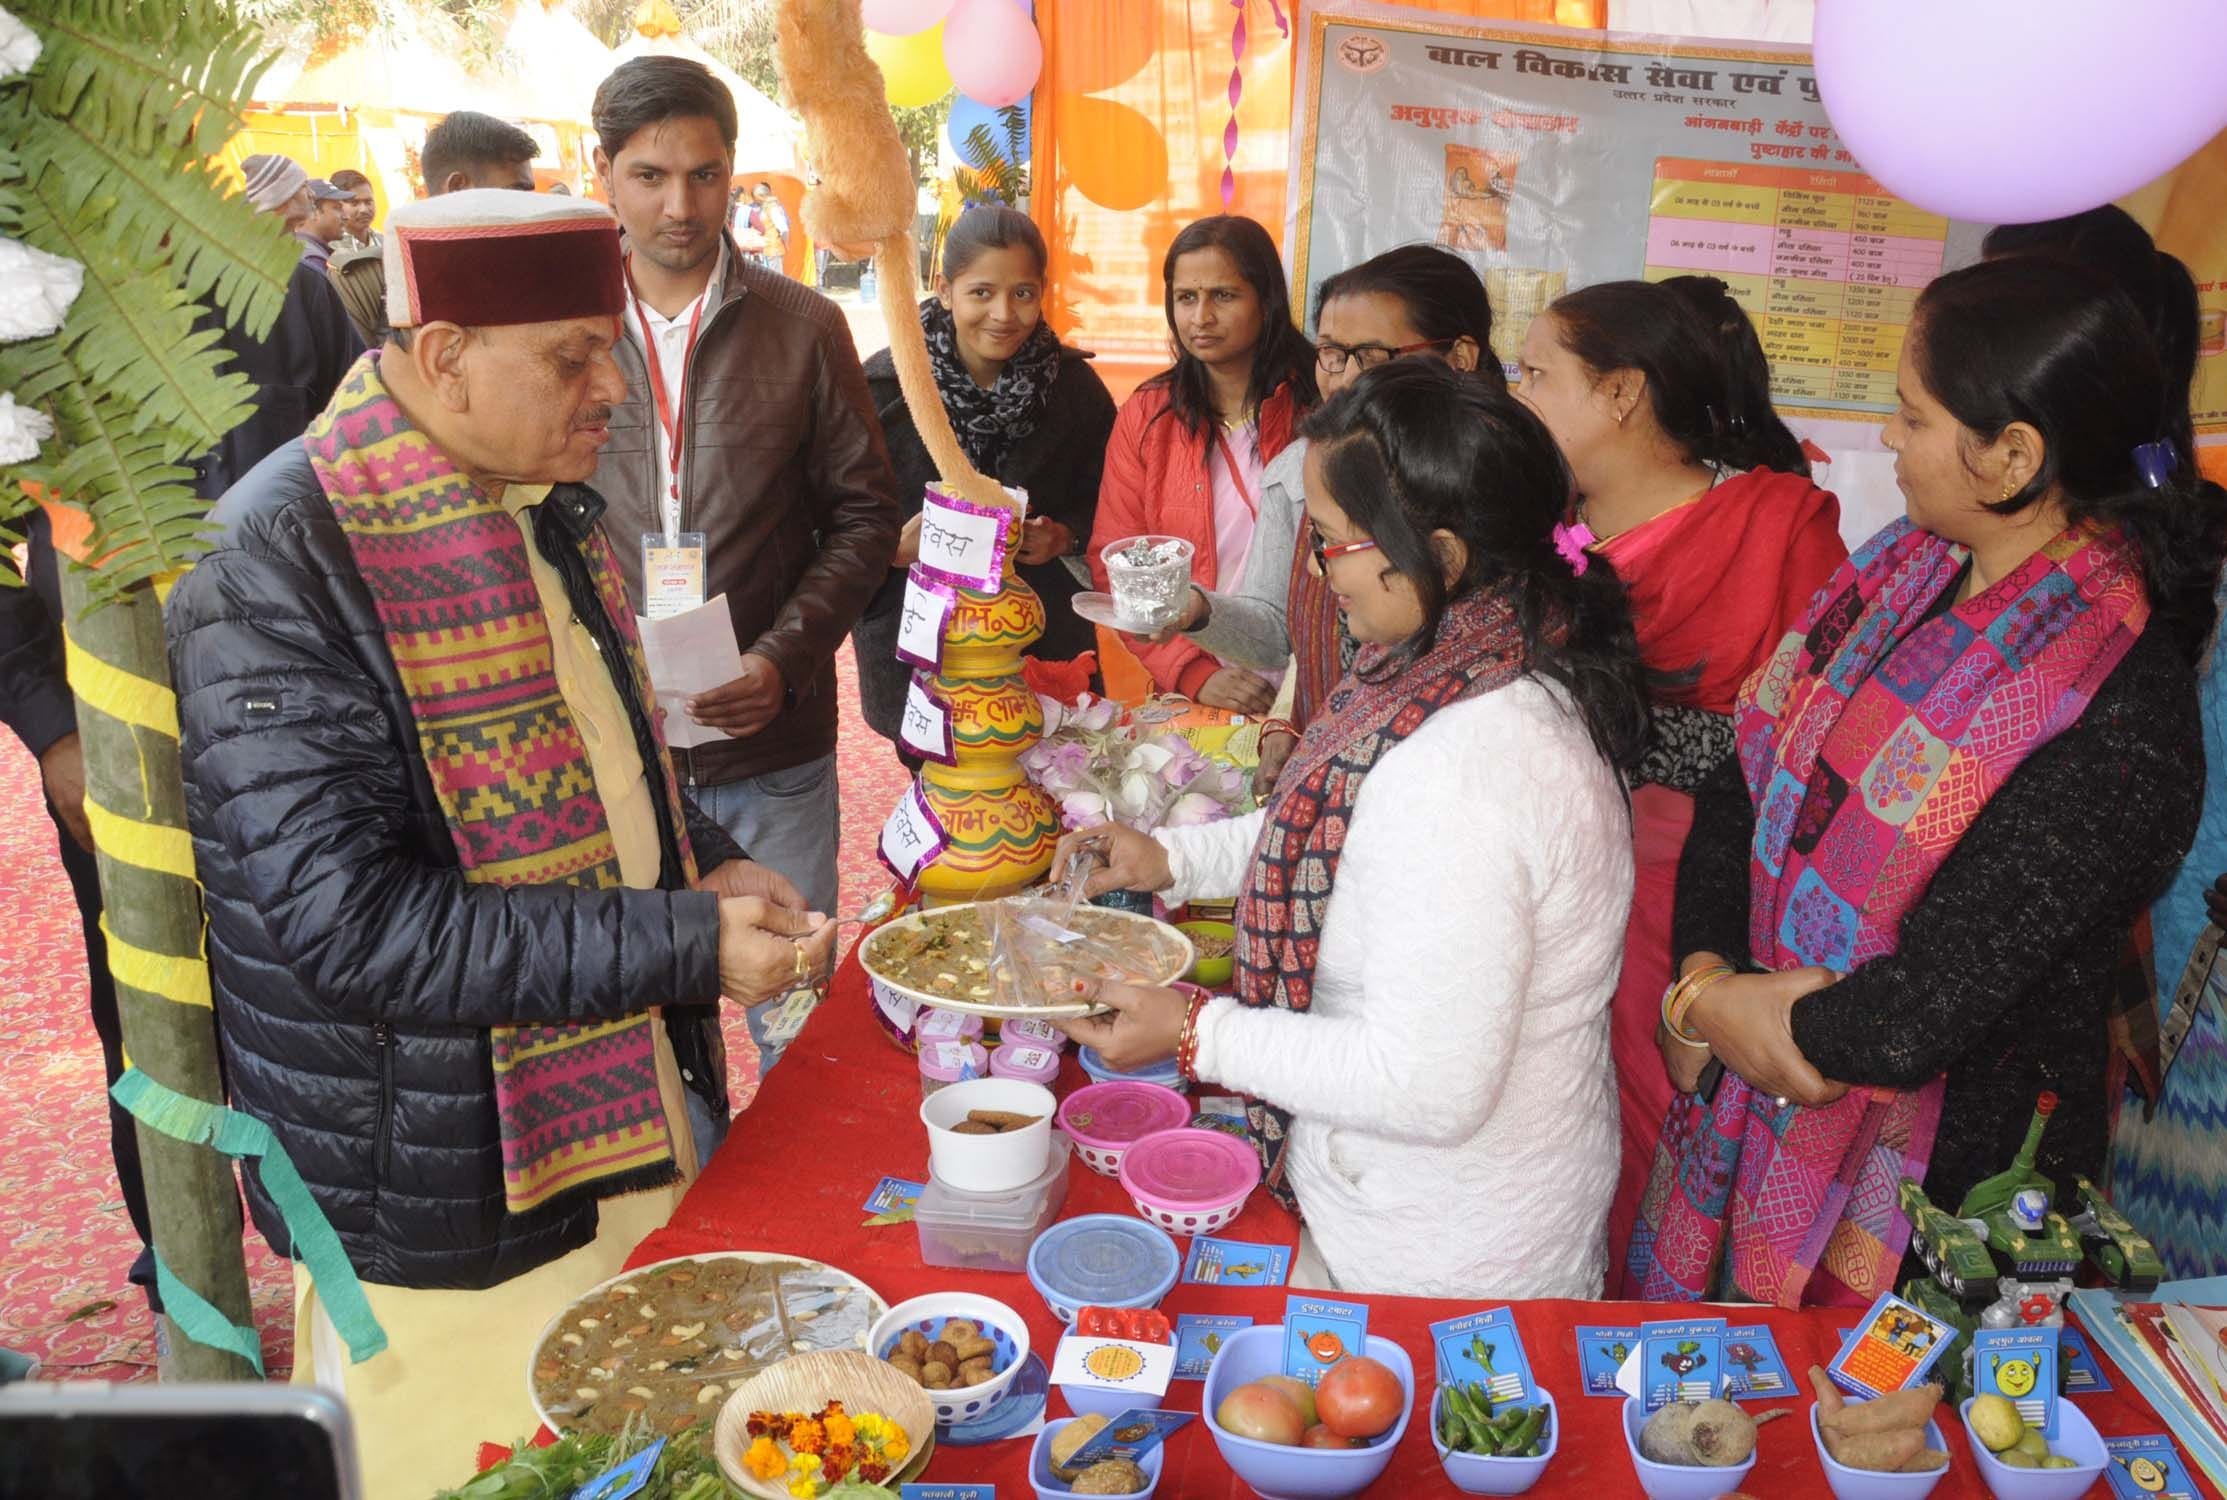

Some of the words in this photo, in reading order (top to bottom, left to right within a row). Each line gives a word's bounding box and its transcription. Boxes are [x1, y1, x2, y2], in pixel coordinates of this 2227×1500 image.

[1425, 45, 1501, 70] बाल
[1513, 49, 1632, 84] विकास
[1644, 62, 1717, 91] सेवा
[1729, 70, 1788, 95] एवं
[1612, 90, 1646, 101] उत्तर
[1654, 91, 1684, 105] प्रदेश
[1692, 96, 1737, 109] सरकार
[1809, 125, 1830, 141] पर
[1750, 142, 1804, 160] पुष्टाहार
[1810, 143, 1828, 161] की
